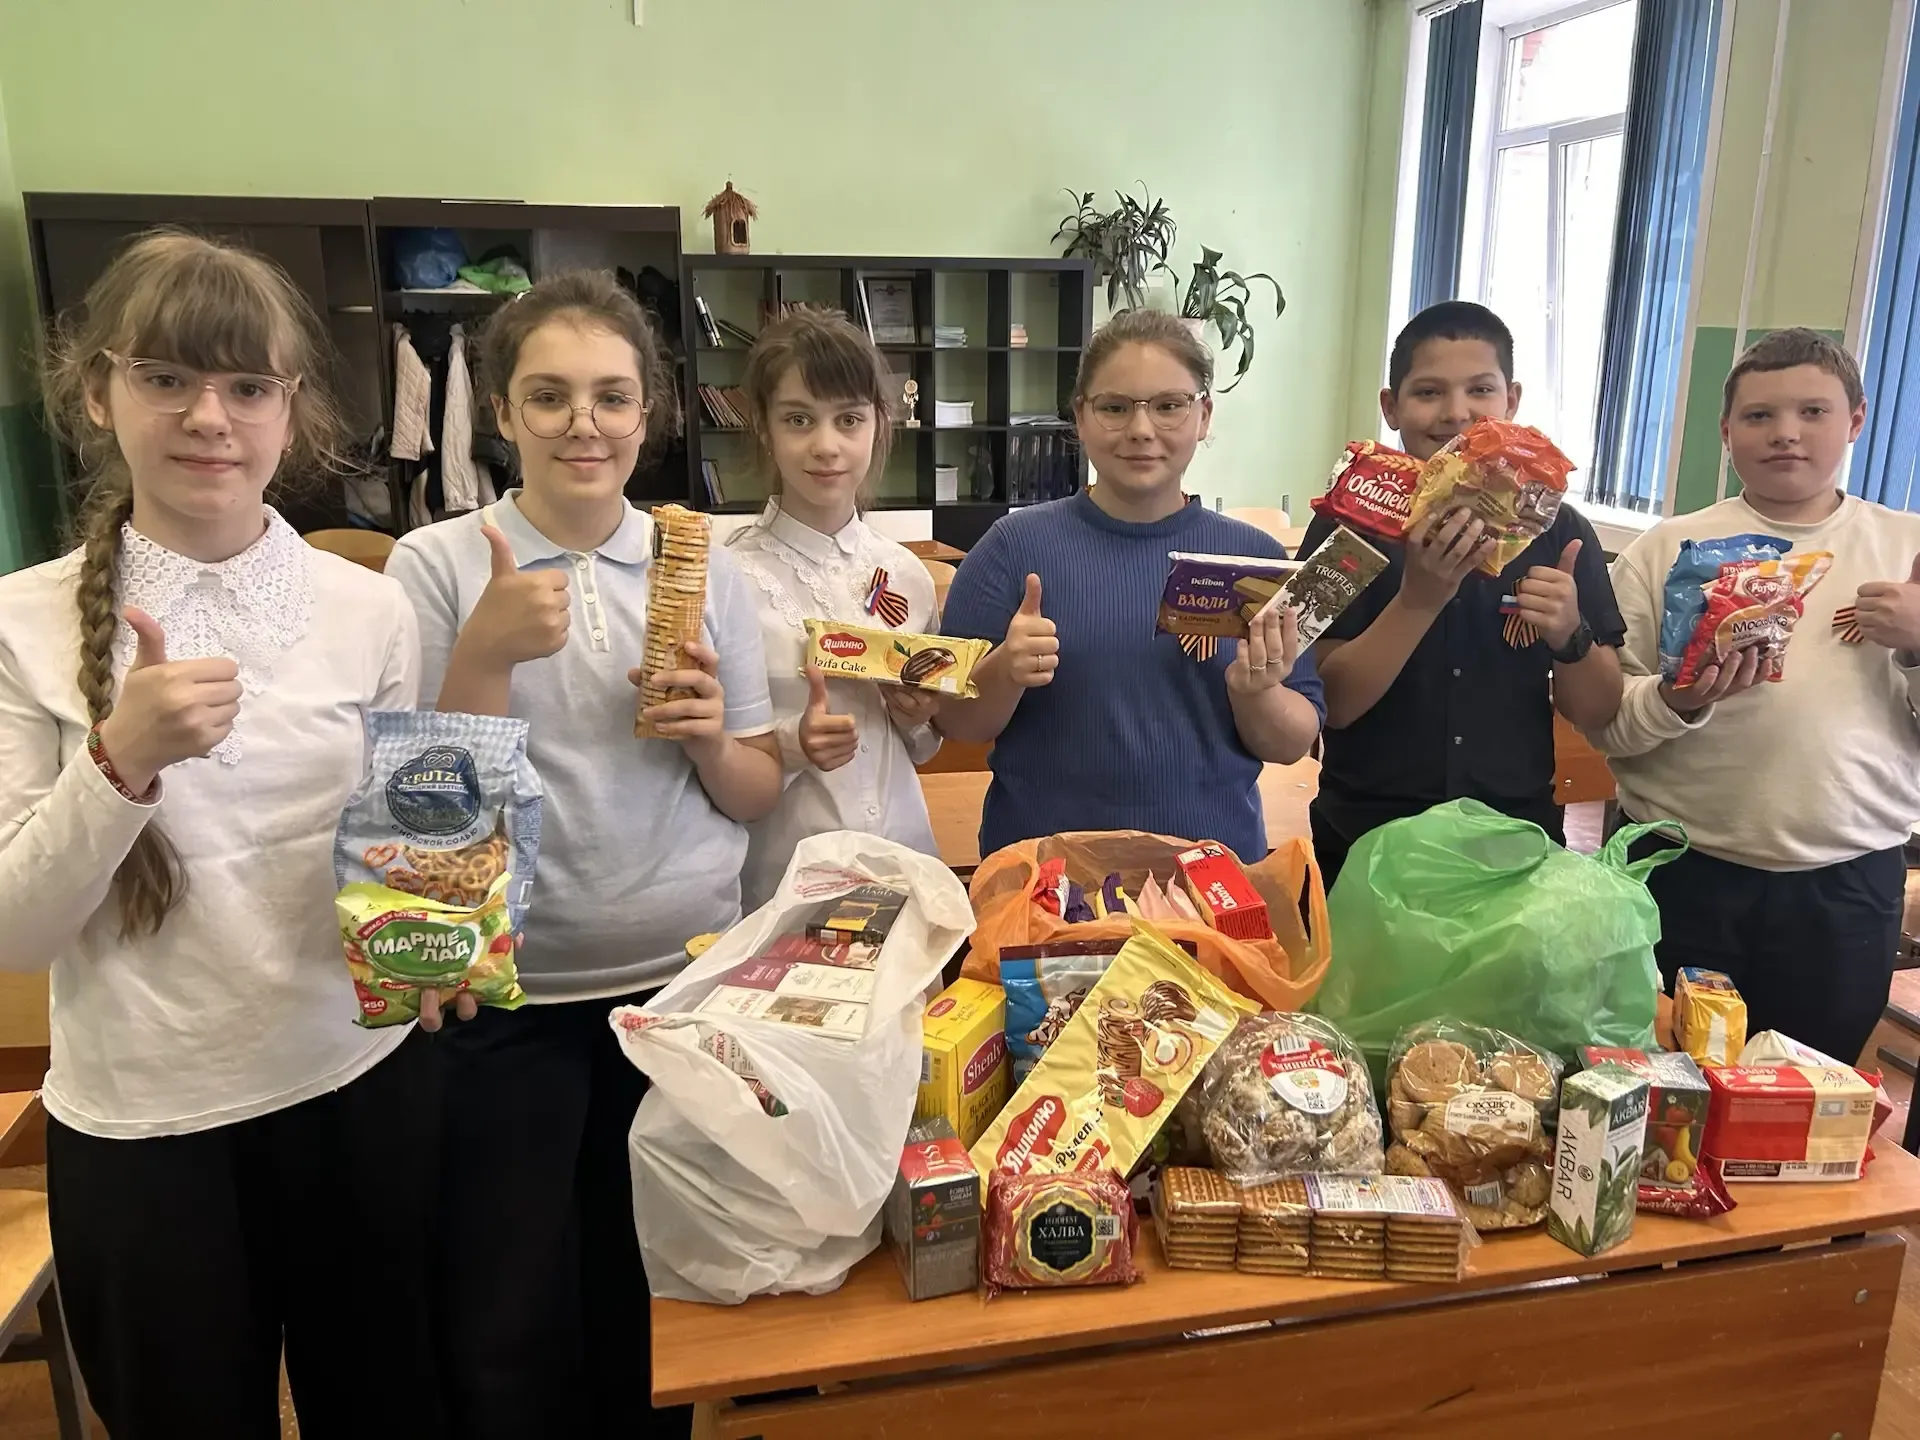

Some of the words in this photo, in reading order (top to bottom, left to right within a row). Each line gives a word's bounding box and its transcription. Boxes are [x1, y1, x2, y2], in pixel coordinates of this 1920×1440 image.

[1354, 496, 1409, 521] ТРАДИЦИОНН
[1315, 564, 1357, 596] TRUFFLES
[1177, 593, 1230, 610] ВАФЛИ
[841, 660, 867, 673] Cake
[399, 829, 443, 847] МОРСКОЙ
[445, 827, 478, 846] СОЛЬЮ
[421, 940, 472, 963] ЛАД
[966, 1041, 1004, 1086] Shenly
[1611, 1102, 1646, 1125] AKBAR
[1556, 1124, 1579, 1201] AKBAR
[1037, 1225, 1086, 1239] ХАЛВА
